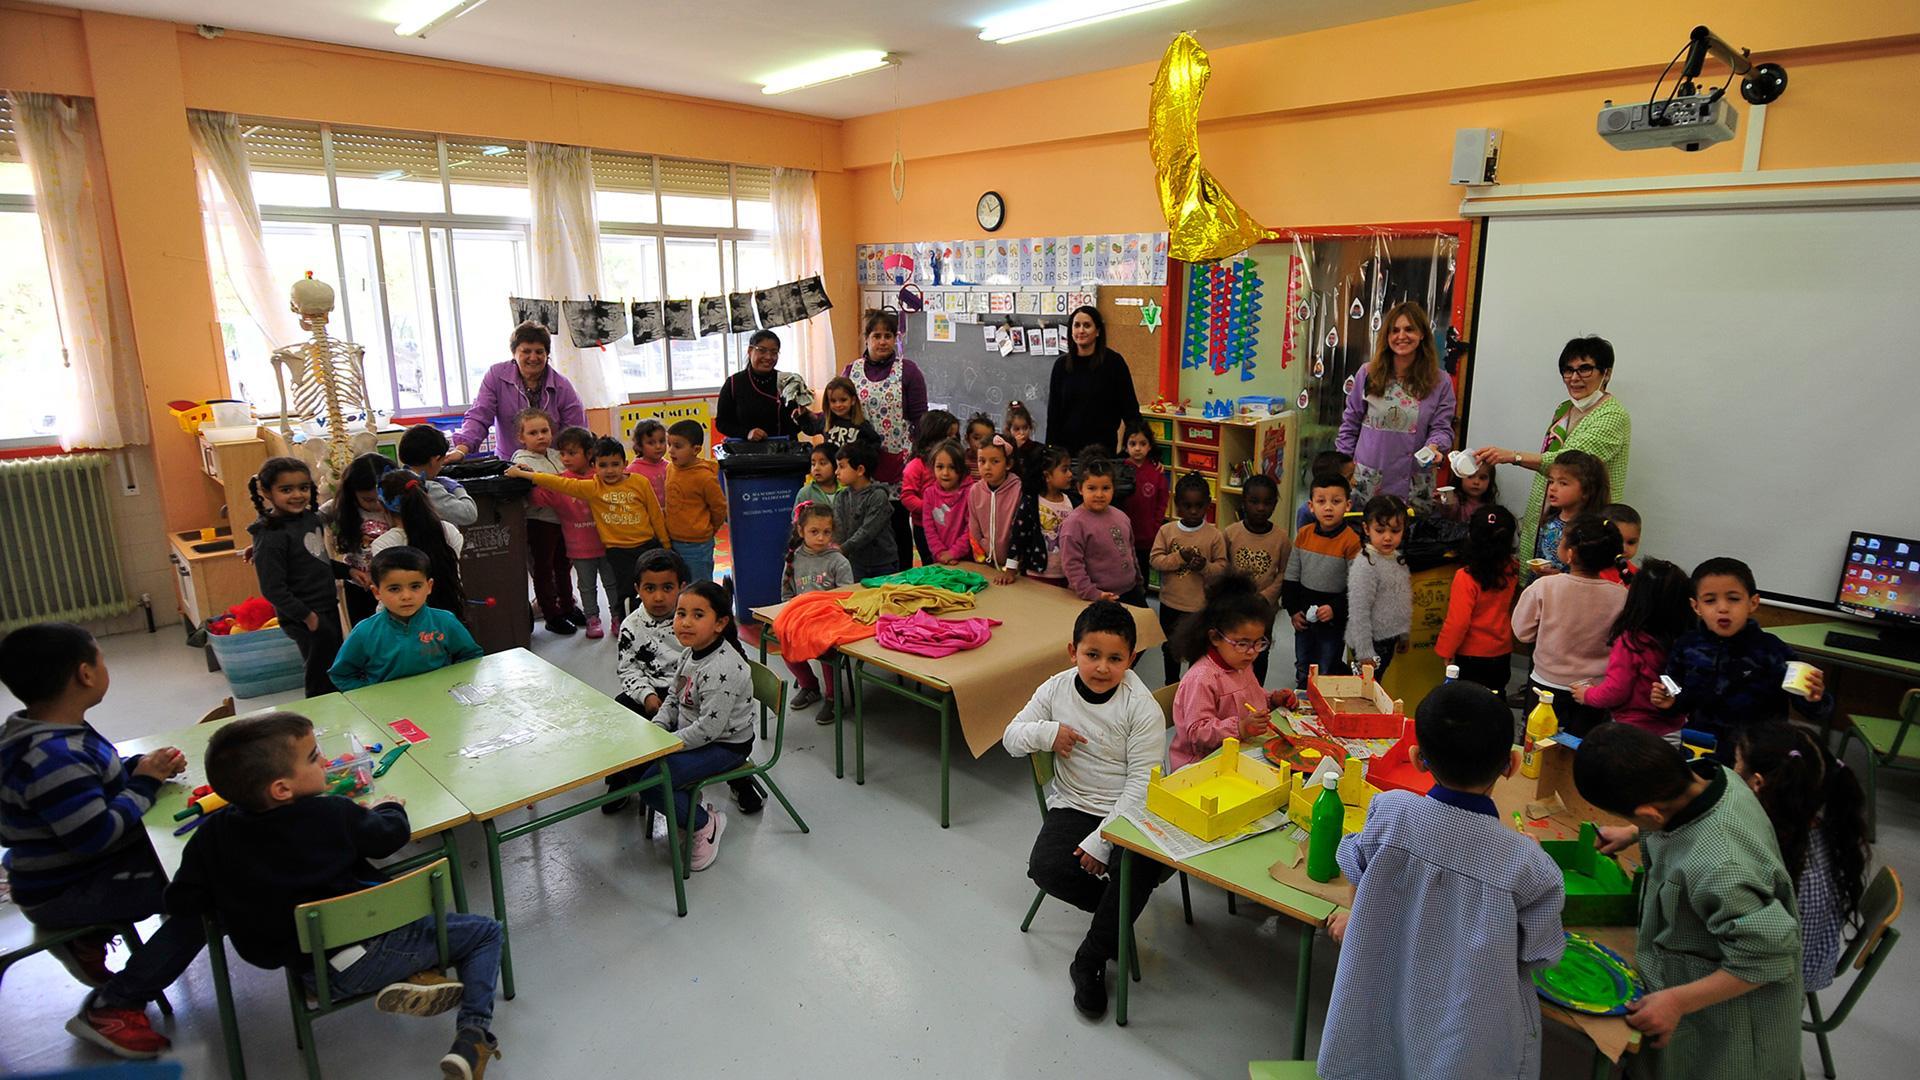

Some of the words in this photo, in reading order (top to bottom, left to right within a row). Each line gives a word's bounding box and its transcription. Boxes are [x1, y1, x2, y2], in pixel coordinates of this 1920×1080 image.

[1030, 295, 1039, 312] 7
[1056, 294, 1066, 312] 8
[1144, 307, 1158, 325] V
[602, 512, 640, 525] WORLD
